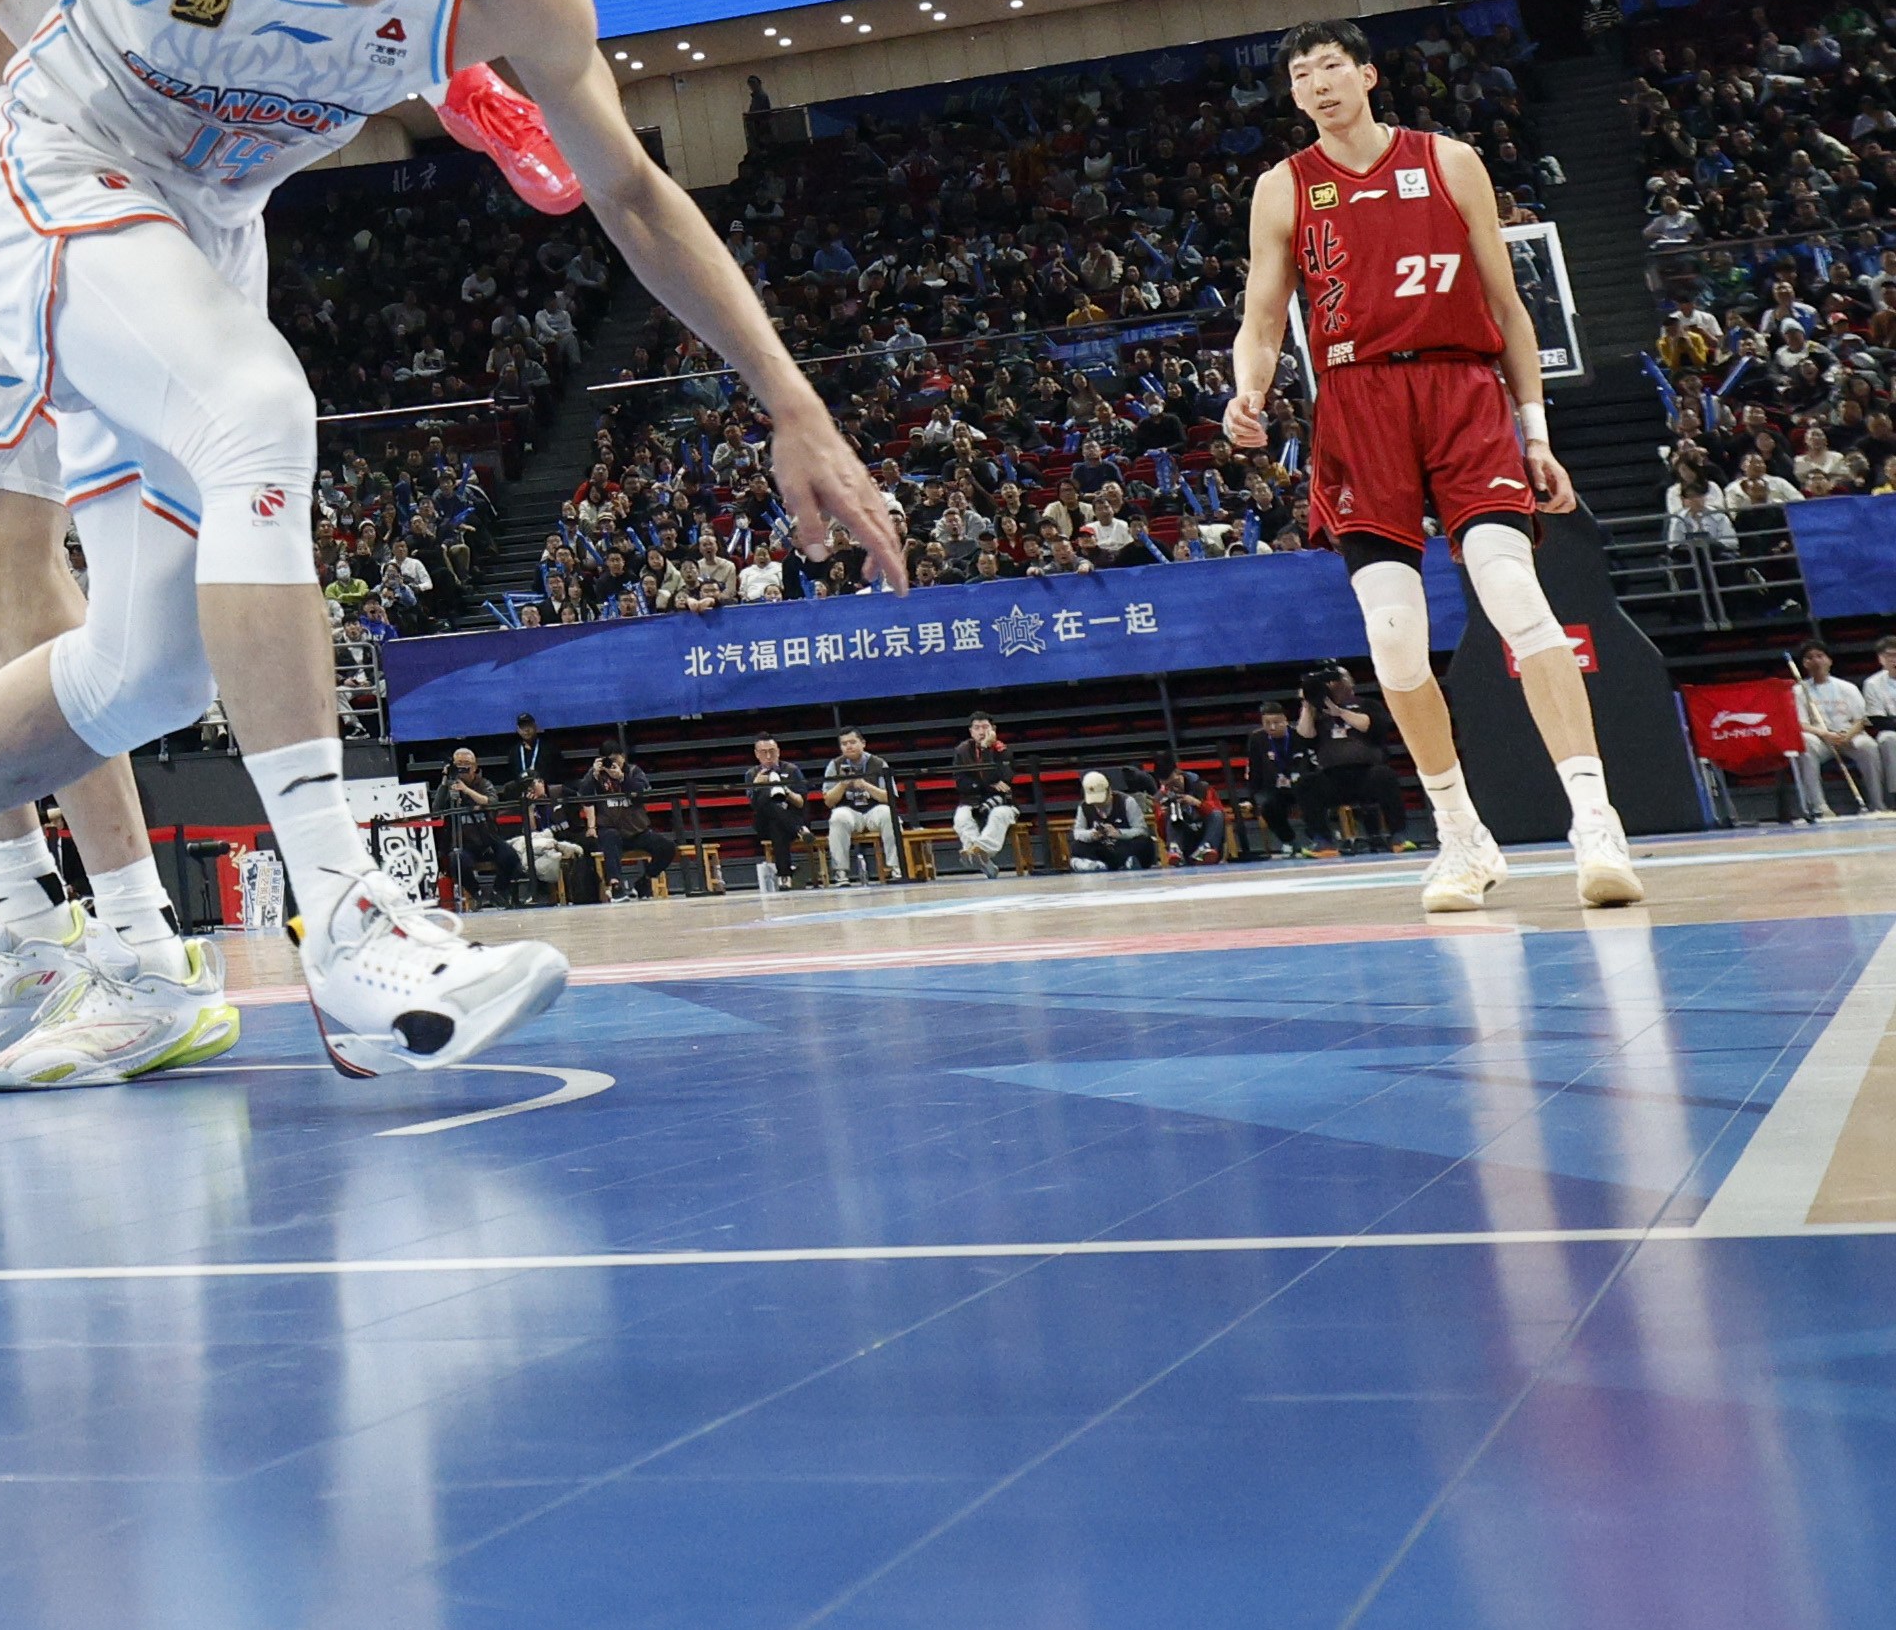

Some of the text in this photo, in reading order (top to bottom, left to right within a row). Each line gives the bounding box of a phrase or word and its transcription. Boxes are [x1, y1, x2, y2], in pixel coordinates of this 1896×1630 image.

[180, 123, 284, 184] 14
[1303, 220, 1348, 336] 北京
[1395, 253, 1461, 297] 27
[684, 601, 1161, 680] 北汽福田和北京男篮 在一起
